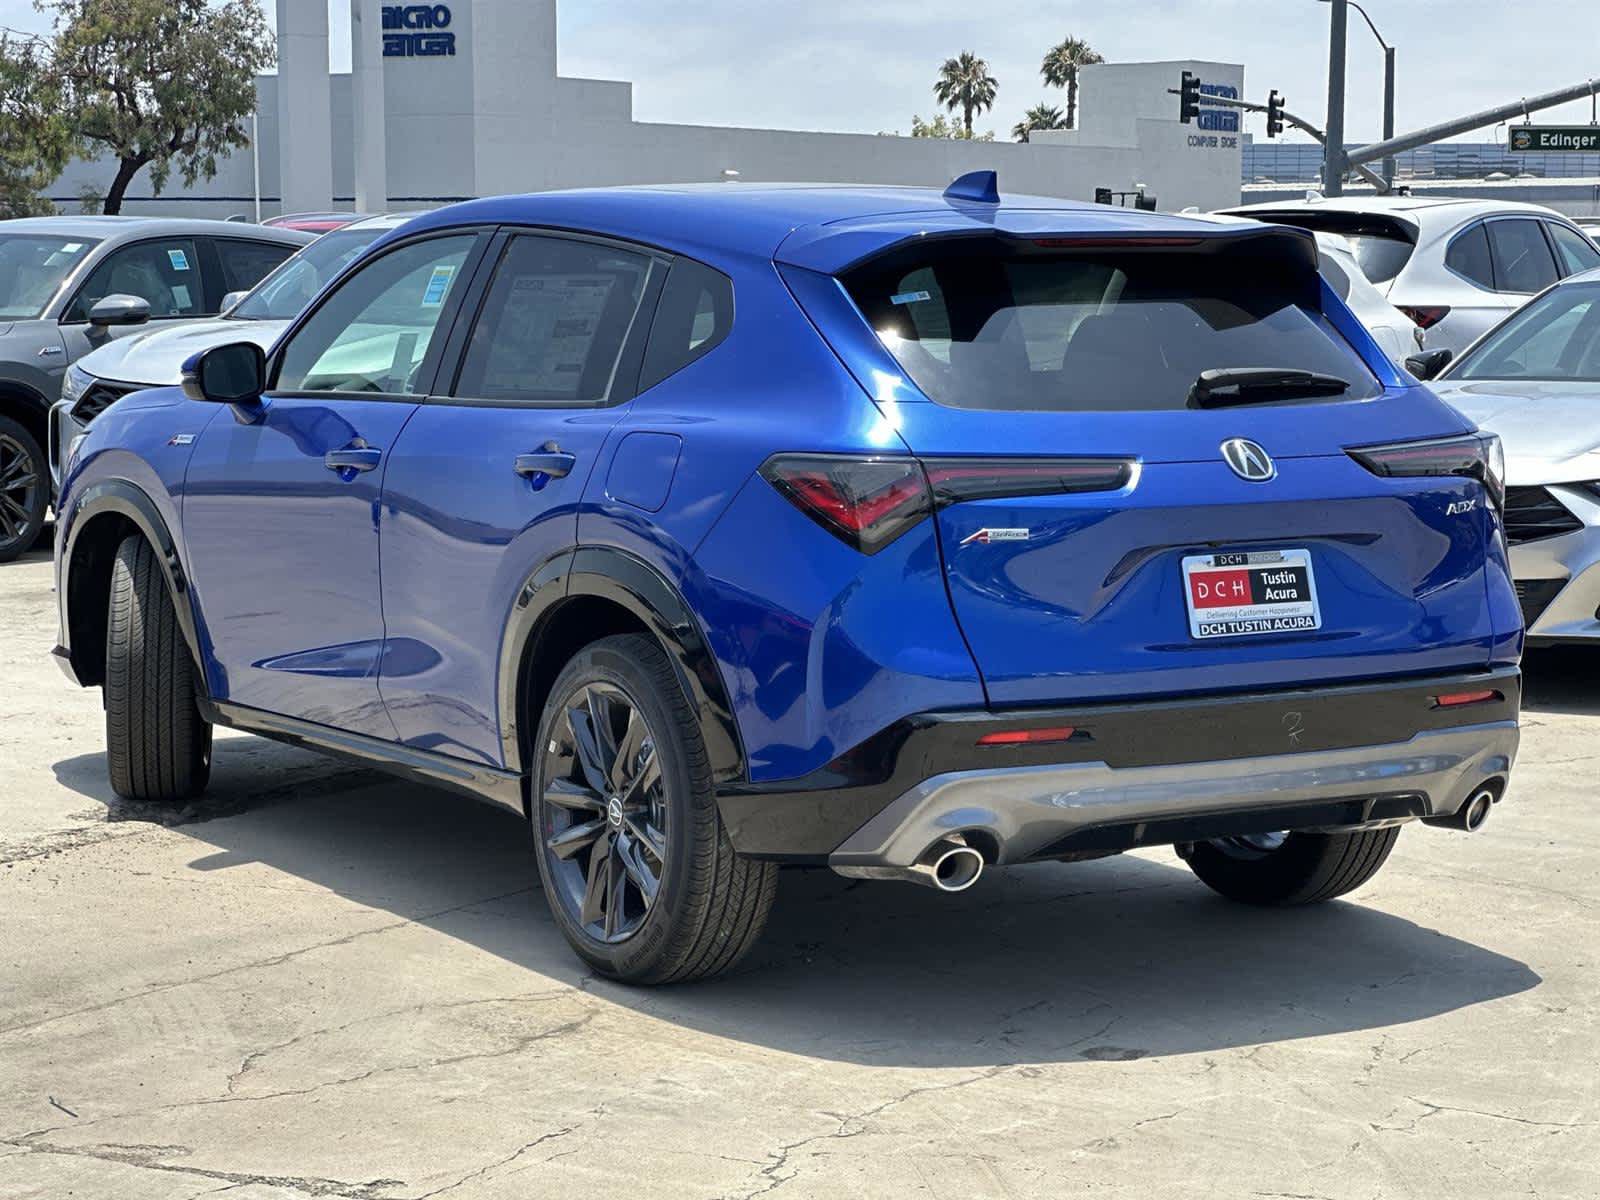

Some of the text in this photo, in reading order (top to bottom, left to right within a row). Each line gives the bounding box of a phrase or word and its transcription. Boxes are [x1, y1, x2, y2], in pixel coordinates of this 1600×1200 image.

[1187, 135, 1218, 148] COMPUTER
[1540, 133, 1597, 149] Edinger
[1446, 499, 1477, 516] ADX
[1220, 553, 1242, 565] DCH
[1260, 570, 1296, 586] Tustin
[1265, 587, 1298, 600] Acura
[1201, 616, 1314, 635] DCH TUSTIN ACURA
